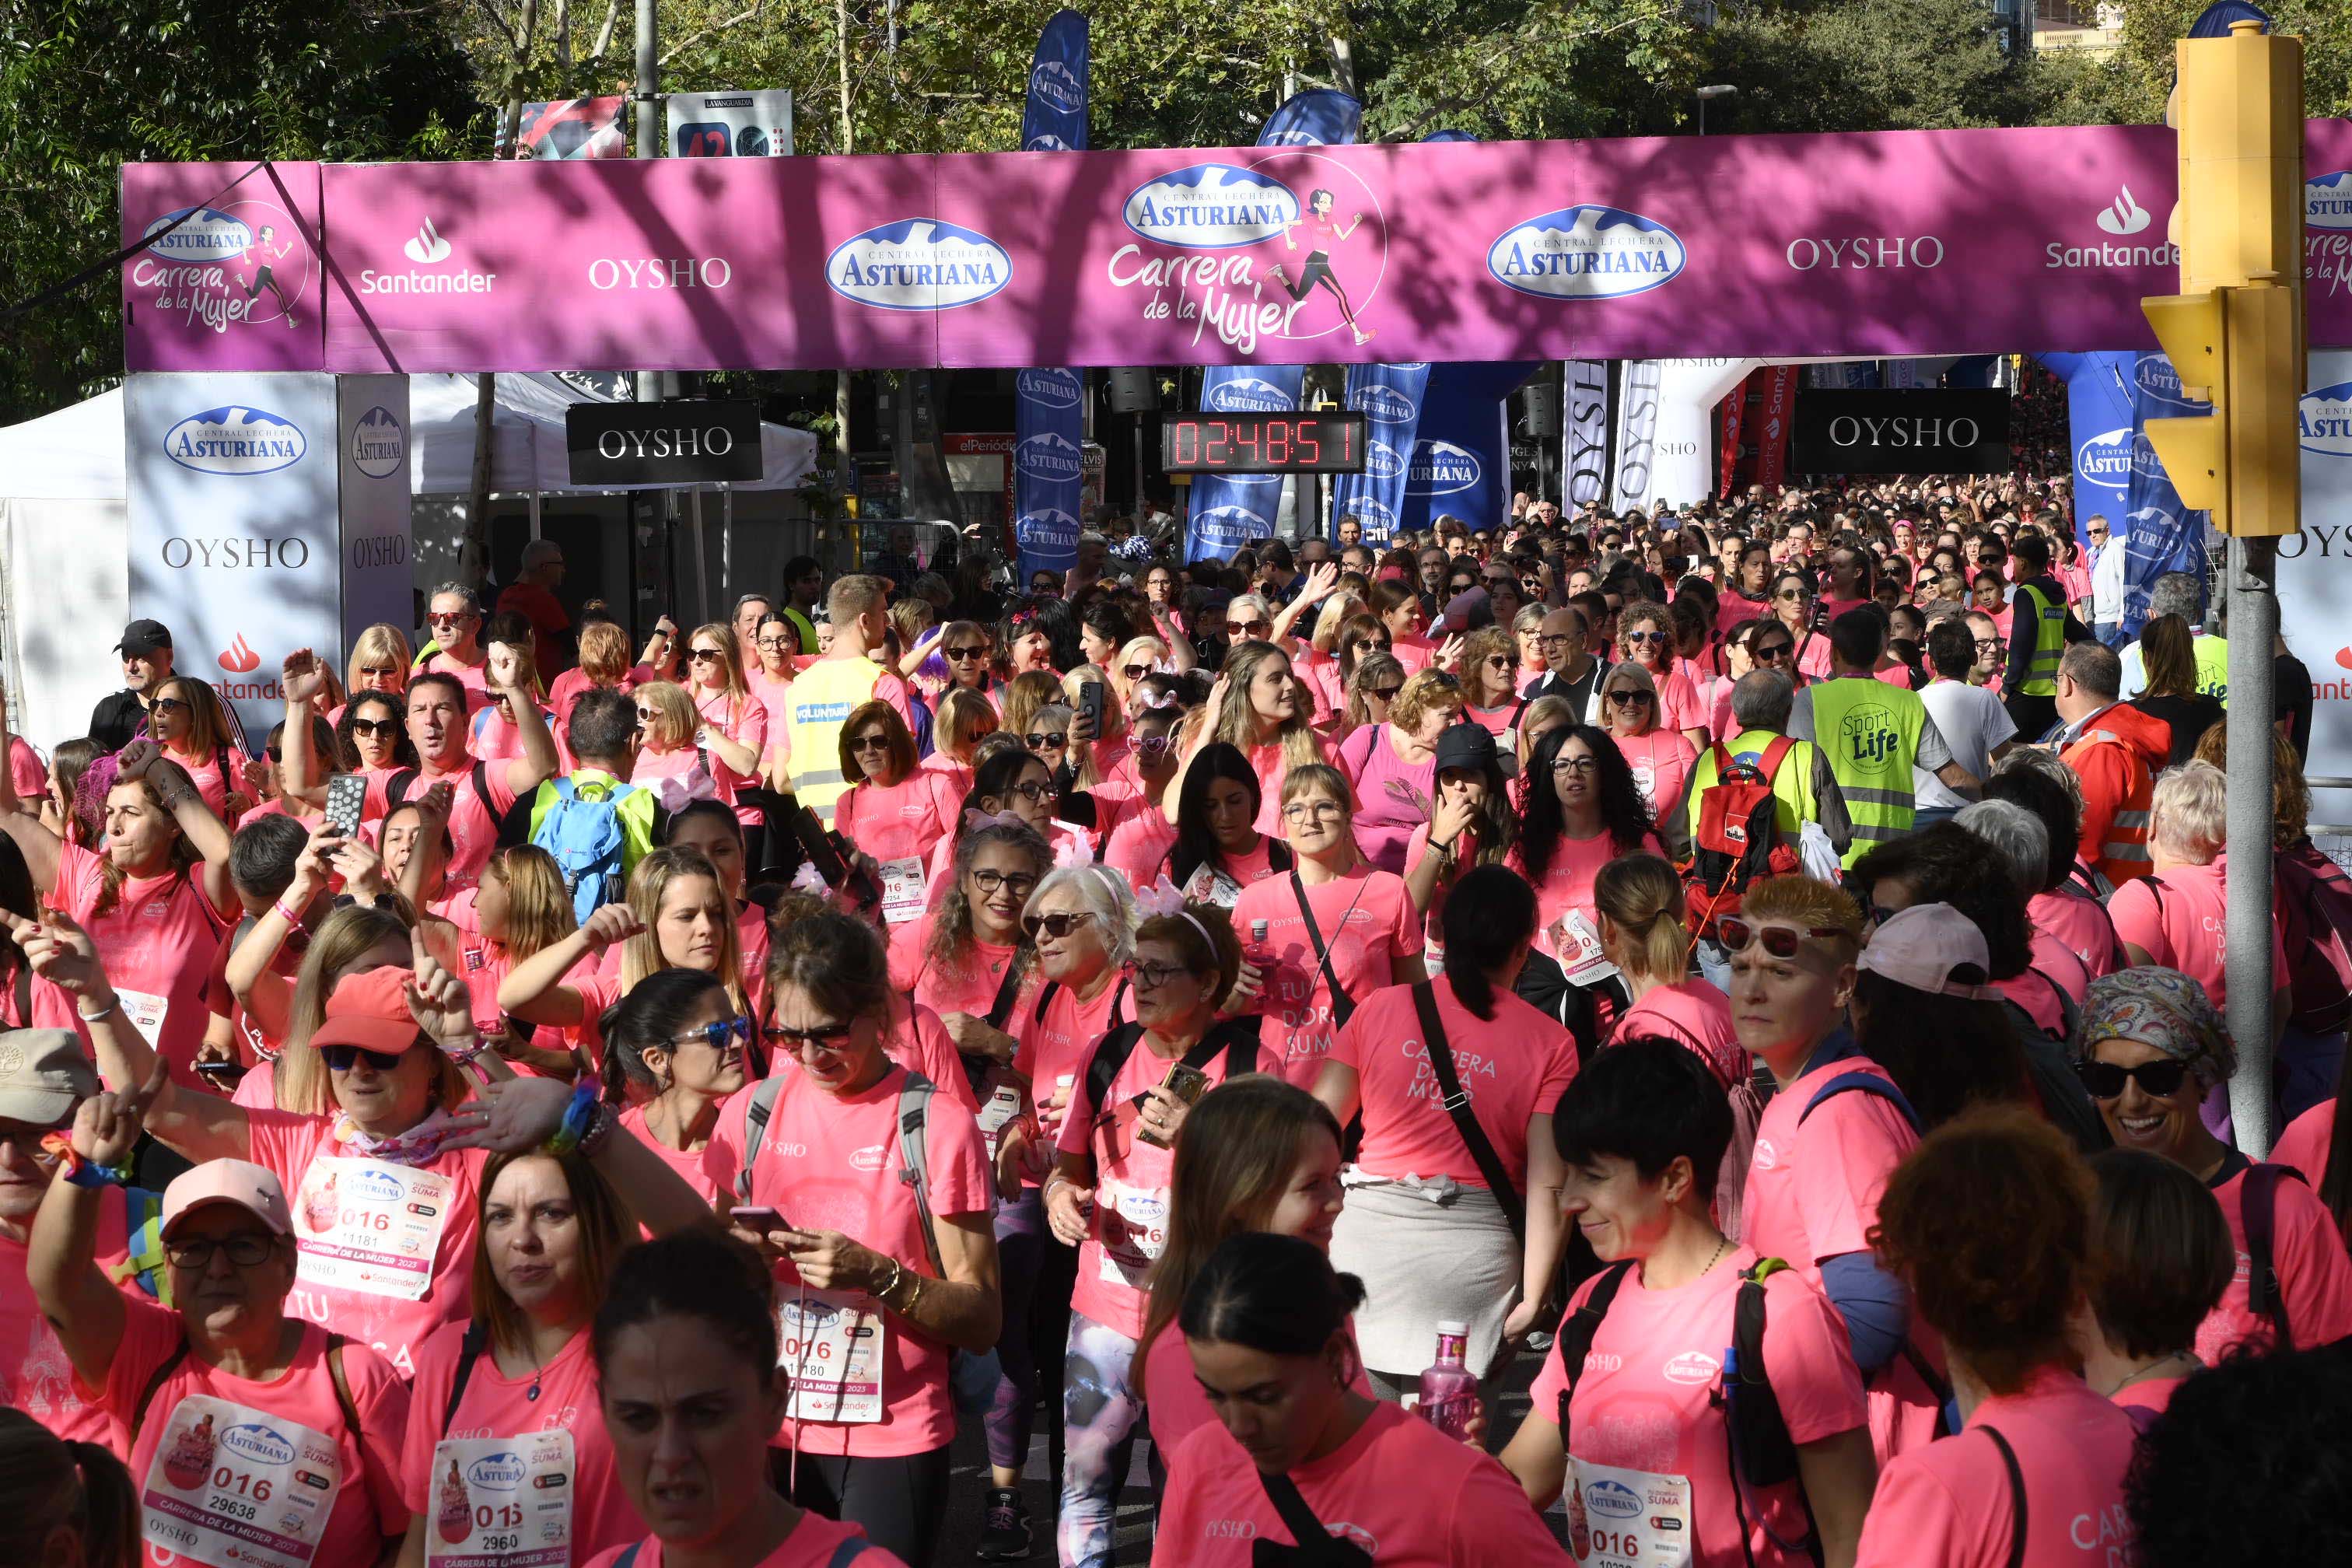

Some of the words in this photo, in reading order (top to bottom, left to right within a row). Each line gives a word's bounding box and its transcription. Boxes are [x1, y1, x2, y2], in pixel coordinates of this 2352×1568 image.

[1224, 192, 1280, 201] LECHERA
[1136, 195, 1285, 228] ASTURIANA
[1533, 238, 1595, 248] CENTRAL
[1601, 236, 1664, 246] LECHERA
[1787, 236, 1944, 270] OYSHO
[2046, 242, 2180, 268] Santande
[840, 253, 998, 287] ASTURIANA
[1108, 244, 1252, 287] Carrera
[1503, 242, 1670, 276] ASTURIANA
[2318, 258, 2332, 279] la
[133, 259, 224, 288] Carrera
[361, 269, 495, 294] Santander
[588, 257, 732, 290] OYSHO
[156, 289, 172, 310] de
[177, 289, 188, 310] la
[187, 286, 259, 334] Mujer
[1143, 291, 1171, 320] de
[1178, 292, 1195, 319] la
[1192, 282, 1307, 355] Mujer
[1022, 373, 1076, 399] ASTURIANA
[1769, 366, 1787, 414] Santa
[1570, 360, 1605, 509] OYSH
[1620, 360, 1657, 499] OYSH
[1829, 416, 1979, 447] OYSHO
[175, 431, 296, 457] ASTURIANA
[356, 433, 401, 460] ASTURIANA
[598, 427, 733, 459] OYSHO
[1020, 447, 1080, 472] ASTURIANA
[1511, 461, 1538, 471] NYA
[1410, 467, 1472, 481] URIANA
[1199, 521, 1264, 538] ASTURIANA
[162, 537, 309, 569] OYSHO
[354, 534, 404, 569] OYSHO
[2196, 663, 2217, 686] ort
[212, 678, 285, 699] tande
[2200, 683, 2228, 701] ife
[1844, 710, 1890, 736] Sport
[1853, 729, 1898, 762] Life
[1726, 830, 1745, 841] Marlbor
[1573, 961, 1594, 972] CARRERA
[1575, 969, 1600, 982] OYSHO
[1283, 1006, 1336, 1027] DOR
[1286, 1033, 1332, 1055] SUM
[1402, 1040, 1496, 1078] CAERA
[765, 1140, 807, 1158] YSHO
[341, 1209, 390, 1230] 016
[339, 1246, 352, 1257] DE
[353, 1249, 366, 1260] LA
[366, 1251, 396, 1265] MUJER
[398, 1259, 418, 1269] 2023
[786, 1338, 831, 1359] 016
[223, 1432, 289, 1462] ASTURIANA
[303, 1451, 336, 1468] SUMA
[532, 1451, 563, 1465] SUMA
[213, 1467, 273, 1502] 016
[209, 1496, 256, 1521] 29638
[1648, 1496, 1679, 1506] SUMA
[149, 1518, 198, 1546] OYSHO
[159, 1499, 205, 1525] CARRERA
[206, 1516, 222, 1530] DE
[222, 1521, 236, 1534] LA
[237, 1524, 272, 1545] MUJER
[274, 1538, 298, 1553] 2023
[1593, 1530, 1638, 1556] 016
[444, 1558, 485, 1568] CARRERA
[487, 1557, 498, 1568] DE
[509, 1554, 543, 1567] MUJER
